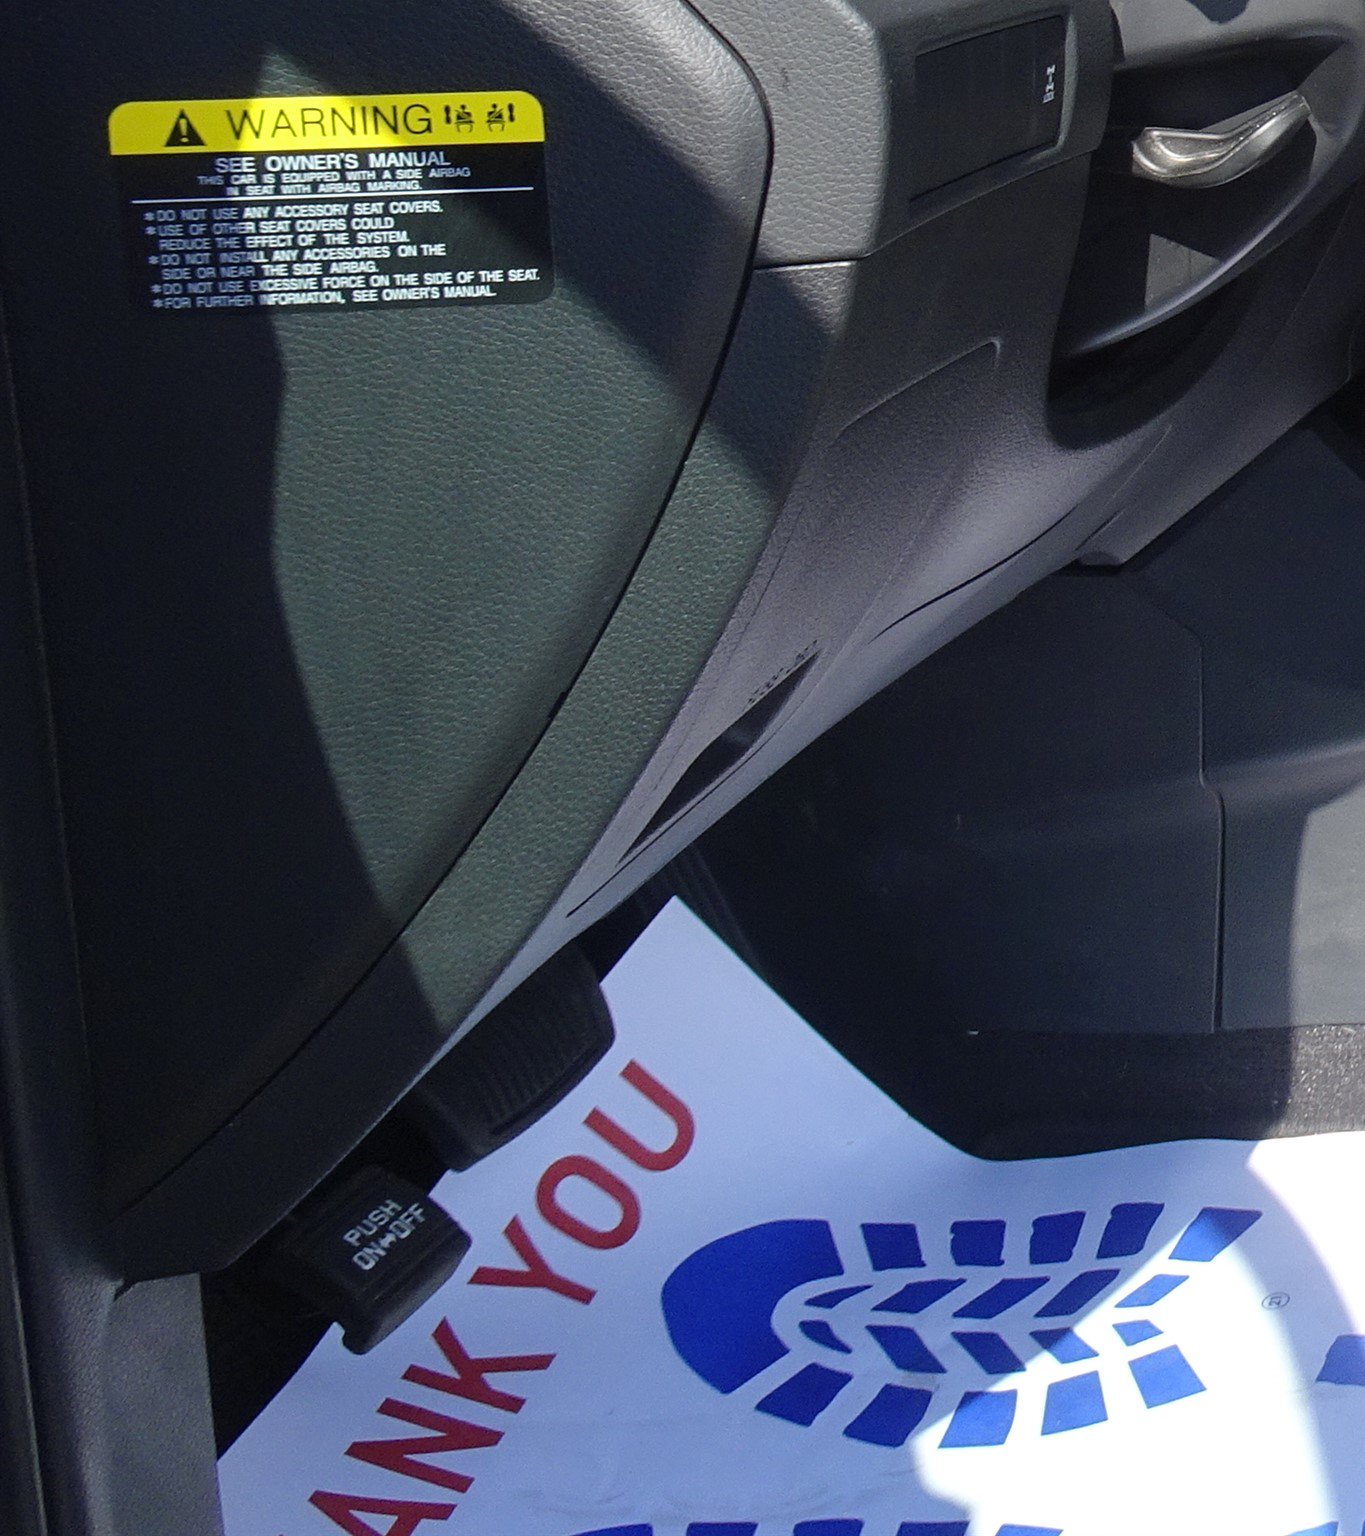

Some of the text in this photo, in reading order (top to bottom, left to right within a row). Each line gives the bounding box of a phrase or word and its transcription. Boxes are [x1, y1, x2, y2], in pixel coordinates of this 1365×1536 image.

[224, 104, 432, 140] WARNING
[215, 151, 451, 172] SEE OWNER'S MANUAL
[197, 167, 471, 185] THIS CAR IS EQUIPPED WITH A SIDE AIRBAG
[226, 180, 422, 196] IN SEAT WITH AIRBAG MARKING.
[157, 200, 443, 221] DO NOT USE ANY ACCESSORY SEAT COVERS.
[157, 217, 394, 236] USE OF OTHER SEAT COVERS COULD
[159, 231, 409, 251] REDUCE THE EFFECT OF THE SYSTEM.
[160, 244, 446, 266] DO NOT INSTALL ANY ACCESSORIES ON THE
[162, 261, 379, 280] SIDE OR NEAR THE SIDE AIRBAG.
[162, 268, 540, 295] DO NOT USE EXCESSIVE FORCE ON THE SIDE OF THE SEAT.
[165, 297, 192, 309] FOR
[196, 295, 254, 308] FURTHER
[258, 291, 345, 306] INFORMATION,
[352, 289, 379, 302] SEE
[382, 287, 440, 301] OWNER'S
[467, 1059, 696, 1305] YOU
[342, 1199, 402, 1246] PUSH
